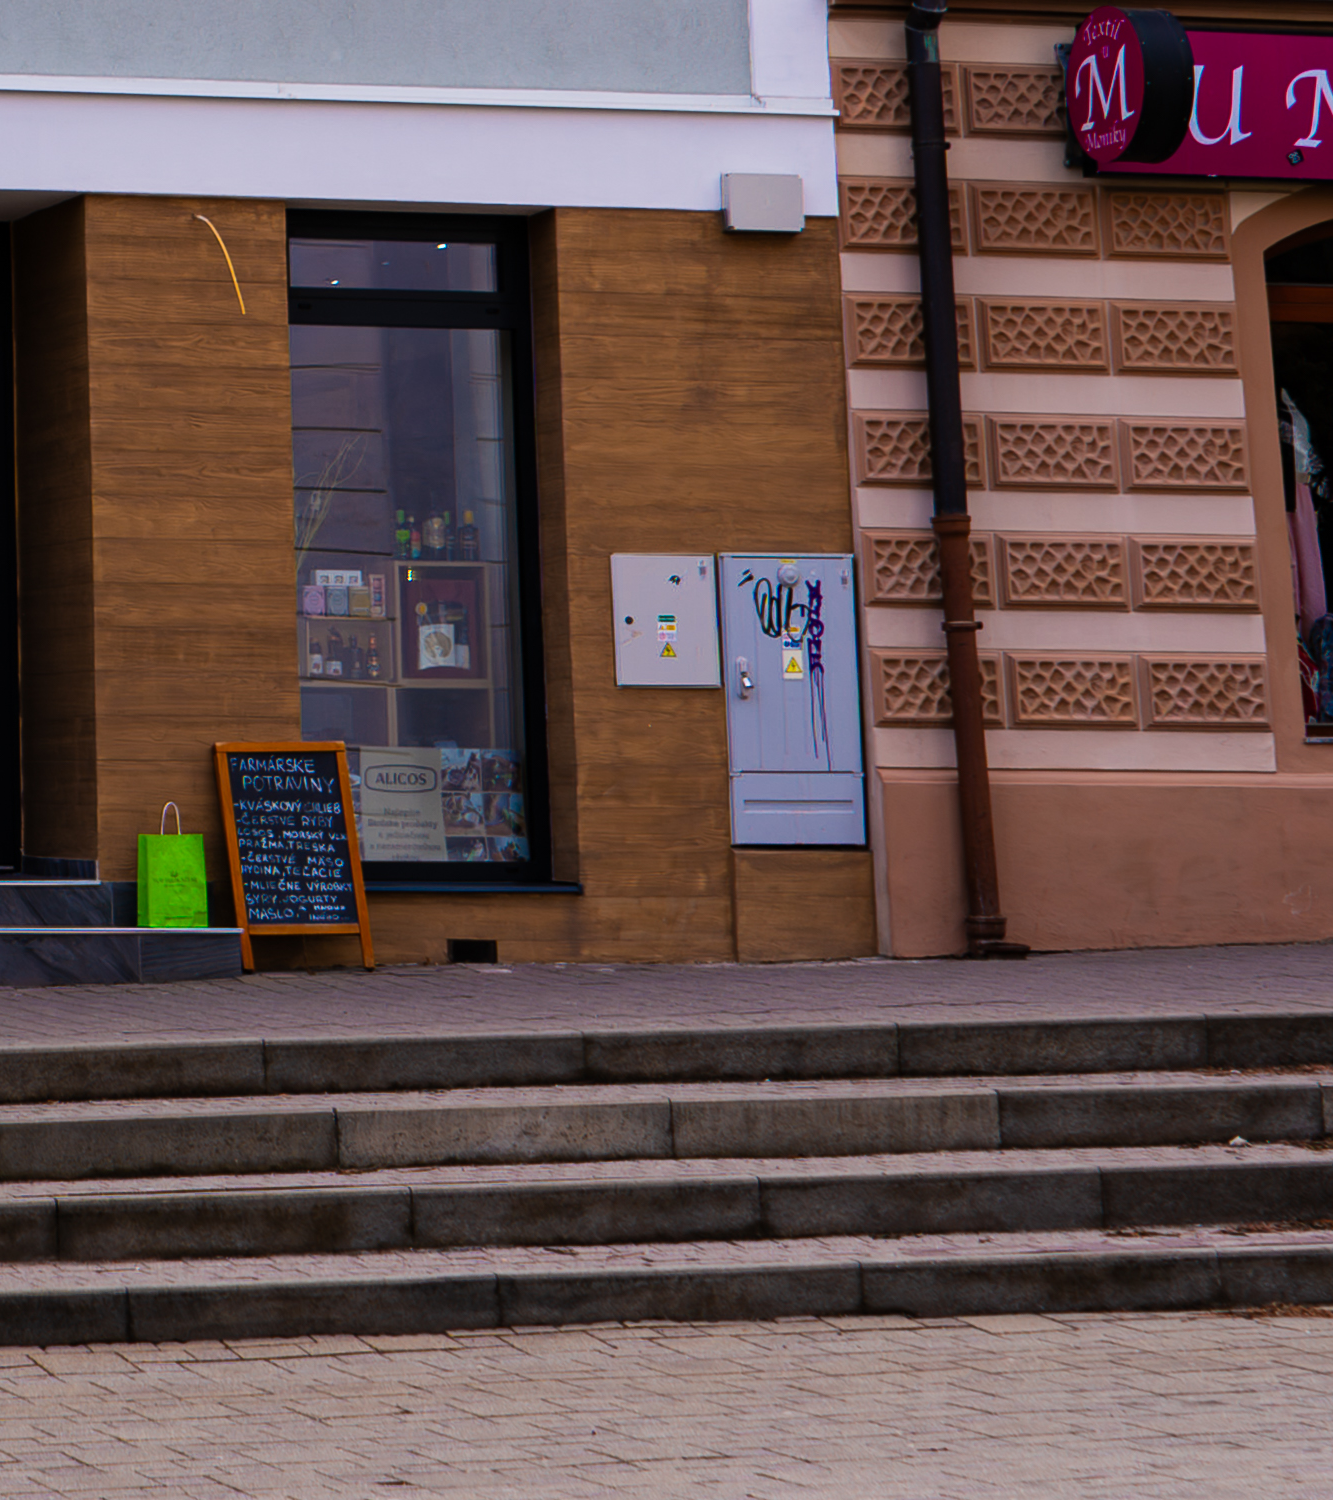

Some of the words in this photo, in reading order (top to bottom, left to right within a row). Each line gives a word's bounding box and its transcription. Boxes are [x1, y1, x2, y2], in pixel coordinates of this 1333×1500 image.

[1083, 19, 1125, 46] Textil
[1086, 125, 1126, 152] Moniky
[230, 755, 315, 773] FARMÁRSKE
[242, 775, 335, 794] POTRAVINY
[375, 772, 427, 786] ALICOS
[306, 880, 353, 892] VÝROBKY
